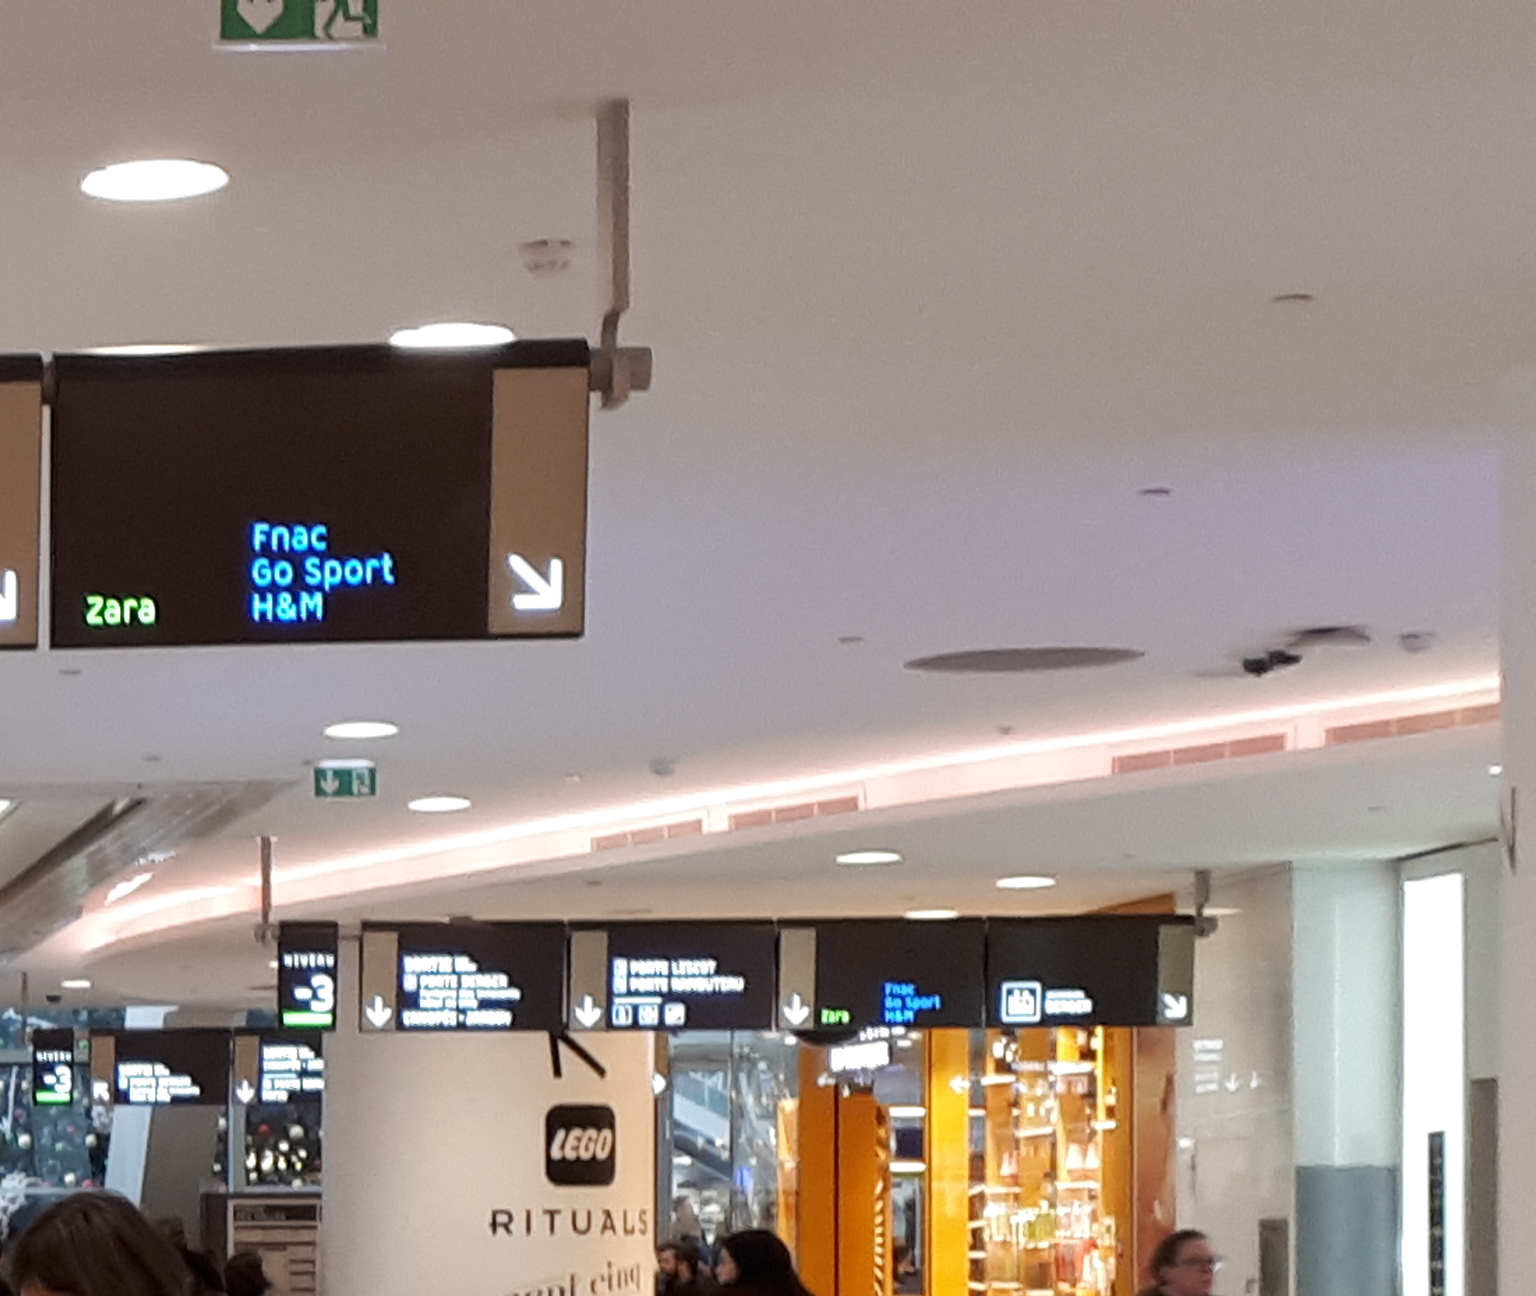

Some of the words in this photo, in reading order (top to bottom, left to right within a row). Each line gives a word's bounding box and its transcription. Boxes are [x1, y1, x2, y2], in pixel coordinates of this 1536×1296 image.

[251, 522, 328, 553] Fnac
[250, 557, 294, 589] Go
[300, 550, 395, 591] Sport
[85, 595, 156, 626] Zara
[250, 589, 327, 624] H&M
[291, 973, 335, 1014] -3
[550, 1127, 613, 1160] LEGO
[489, 1208, 647, 1236] RITUALS
